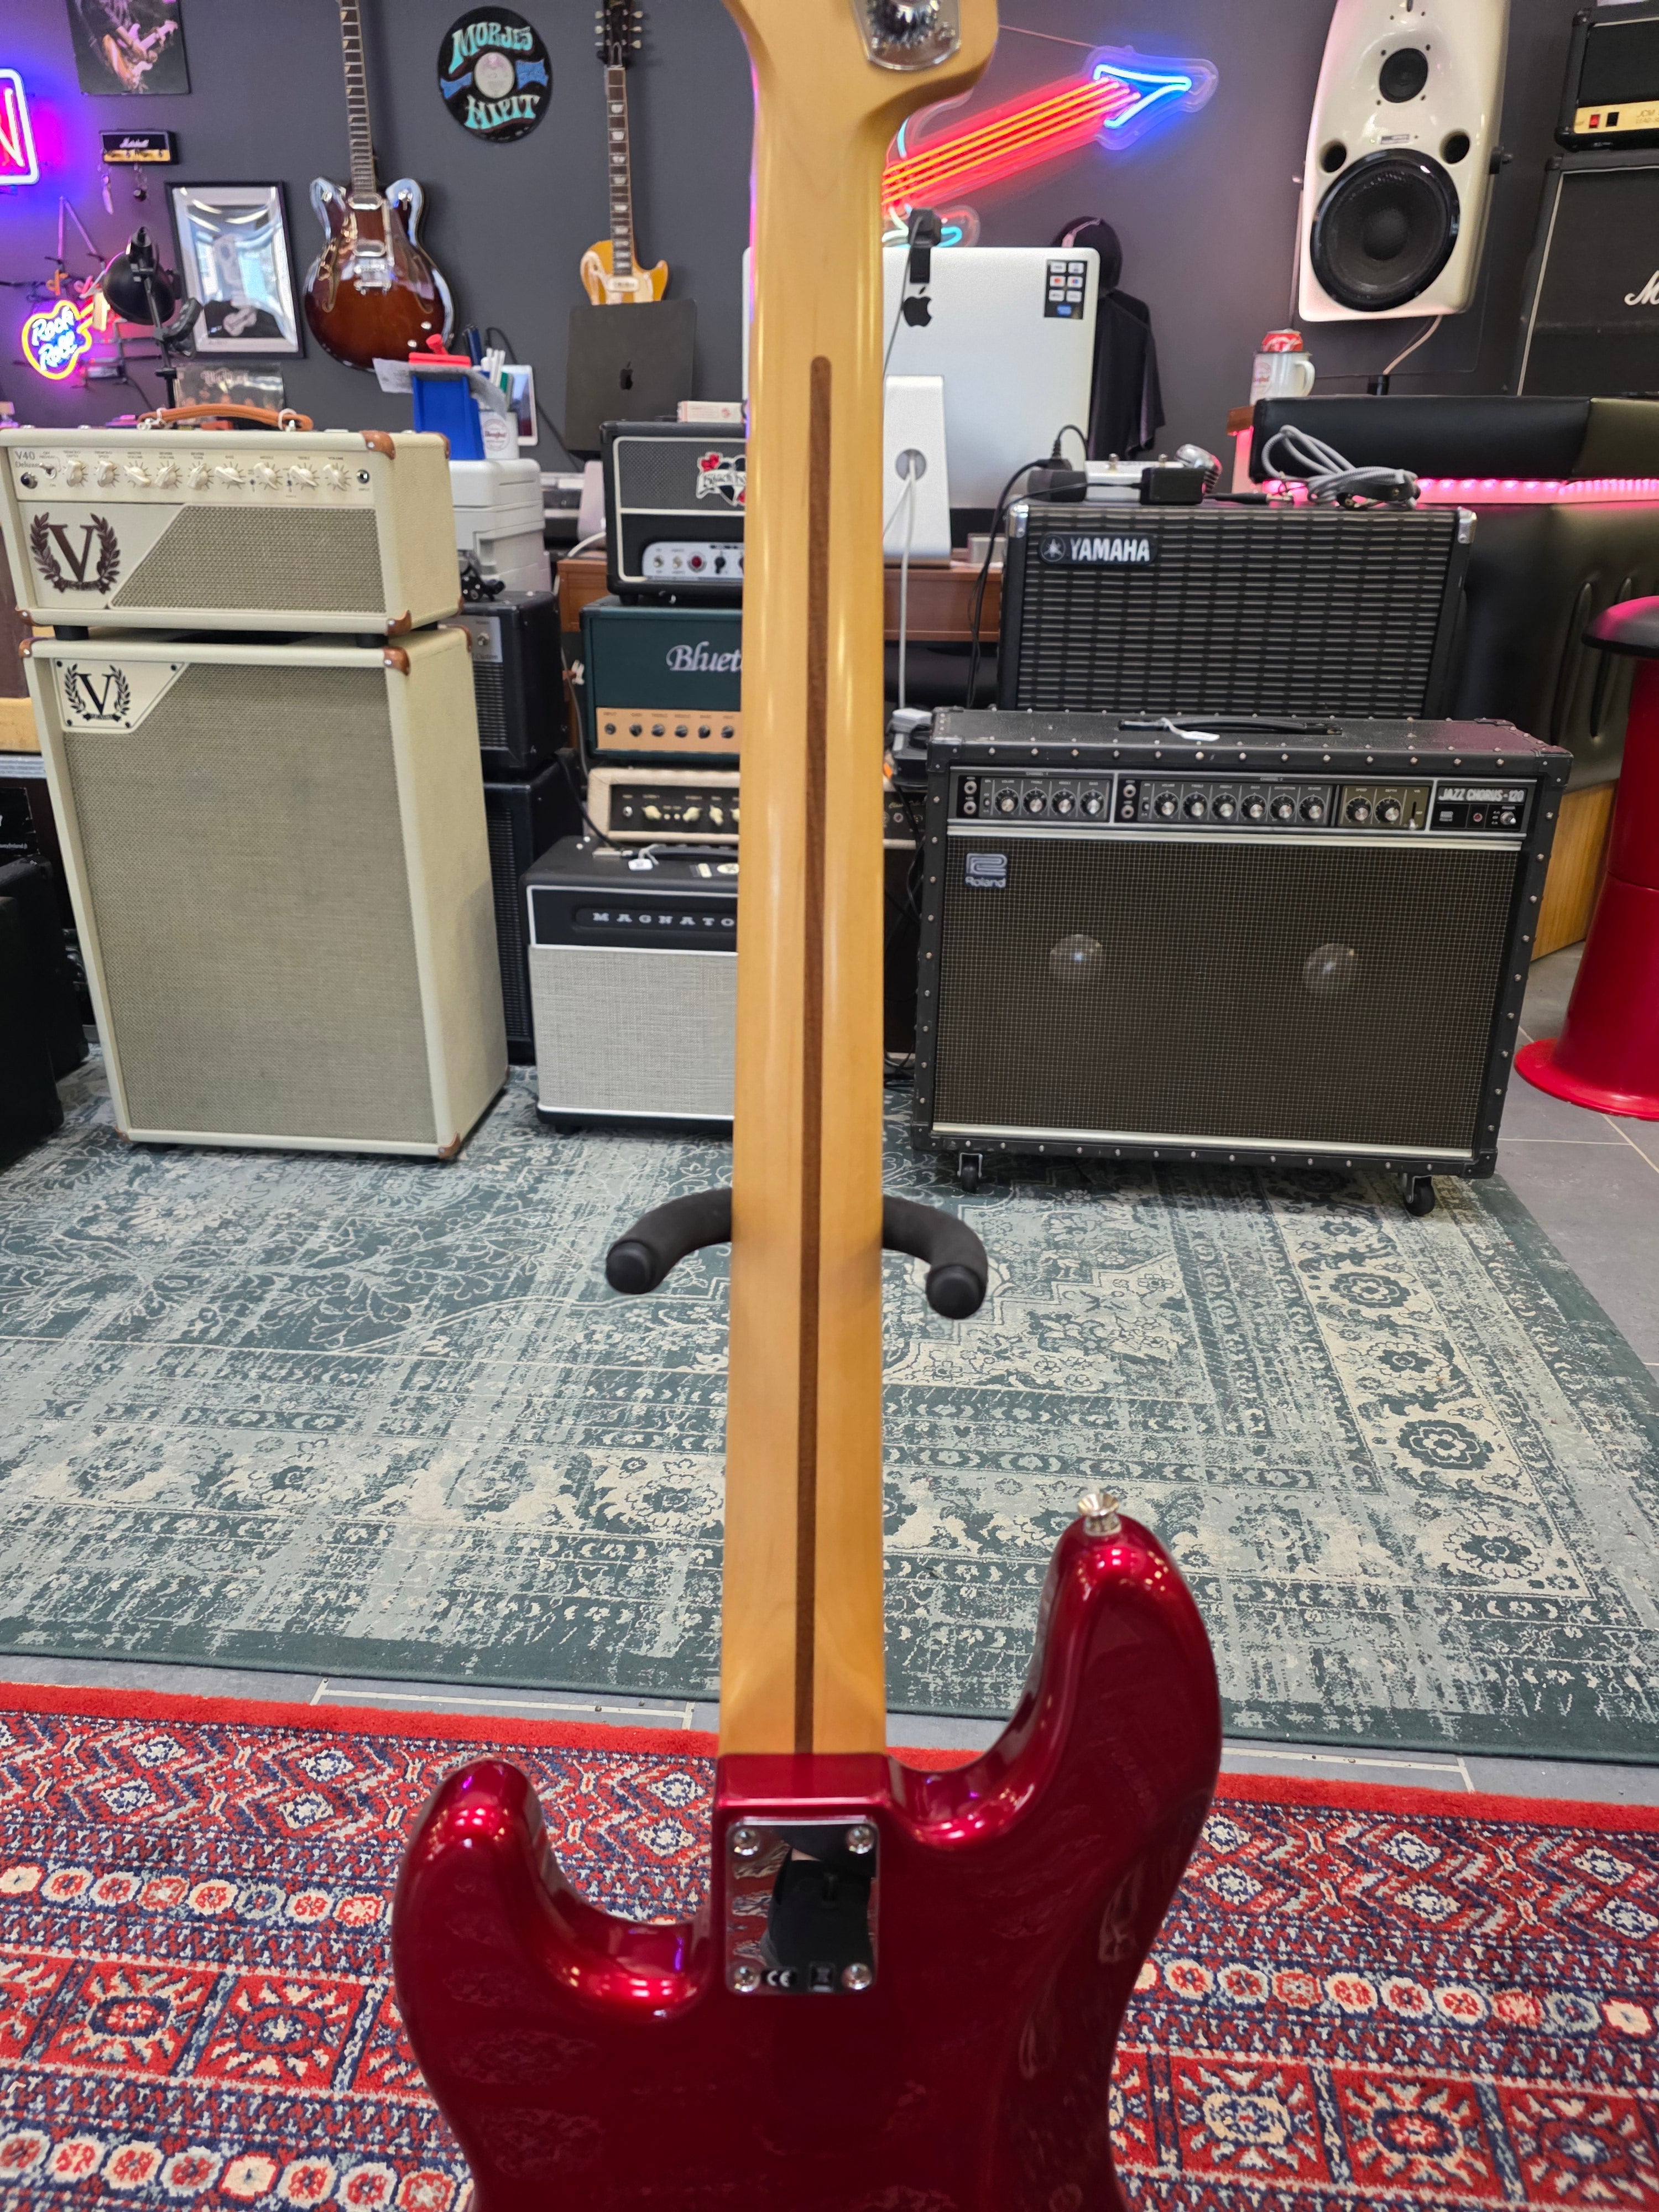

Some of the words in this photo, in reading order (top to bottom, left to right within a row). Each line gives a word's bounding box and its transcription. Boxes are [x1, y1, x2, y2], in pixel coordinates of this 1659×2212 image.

[463, 93, 541, 130] HIPIT
[15, 451, 35, 460] V40
[1070, 538, 1150, 562] YAMAHA
[666, 641, 743, 672] Bluet
[1438, 788, 1465, 801] JAZZ
[965, 877, 1006, 888] Roland
